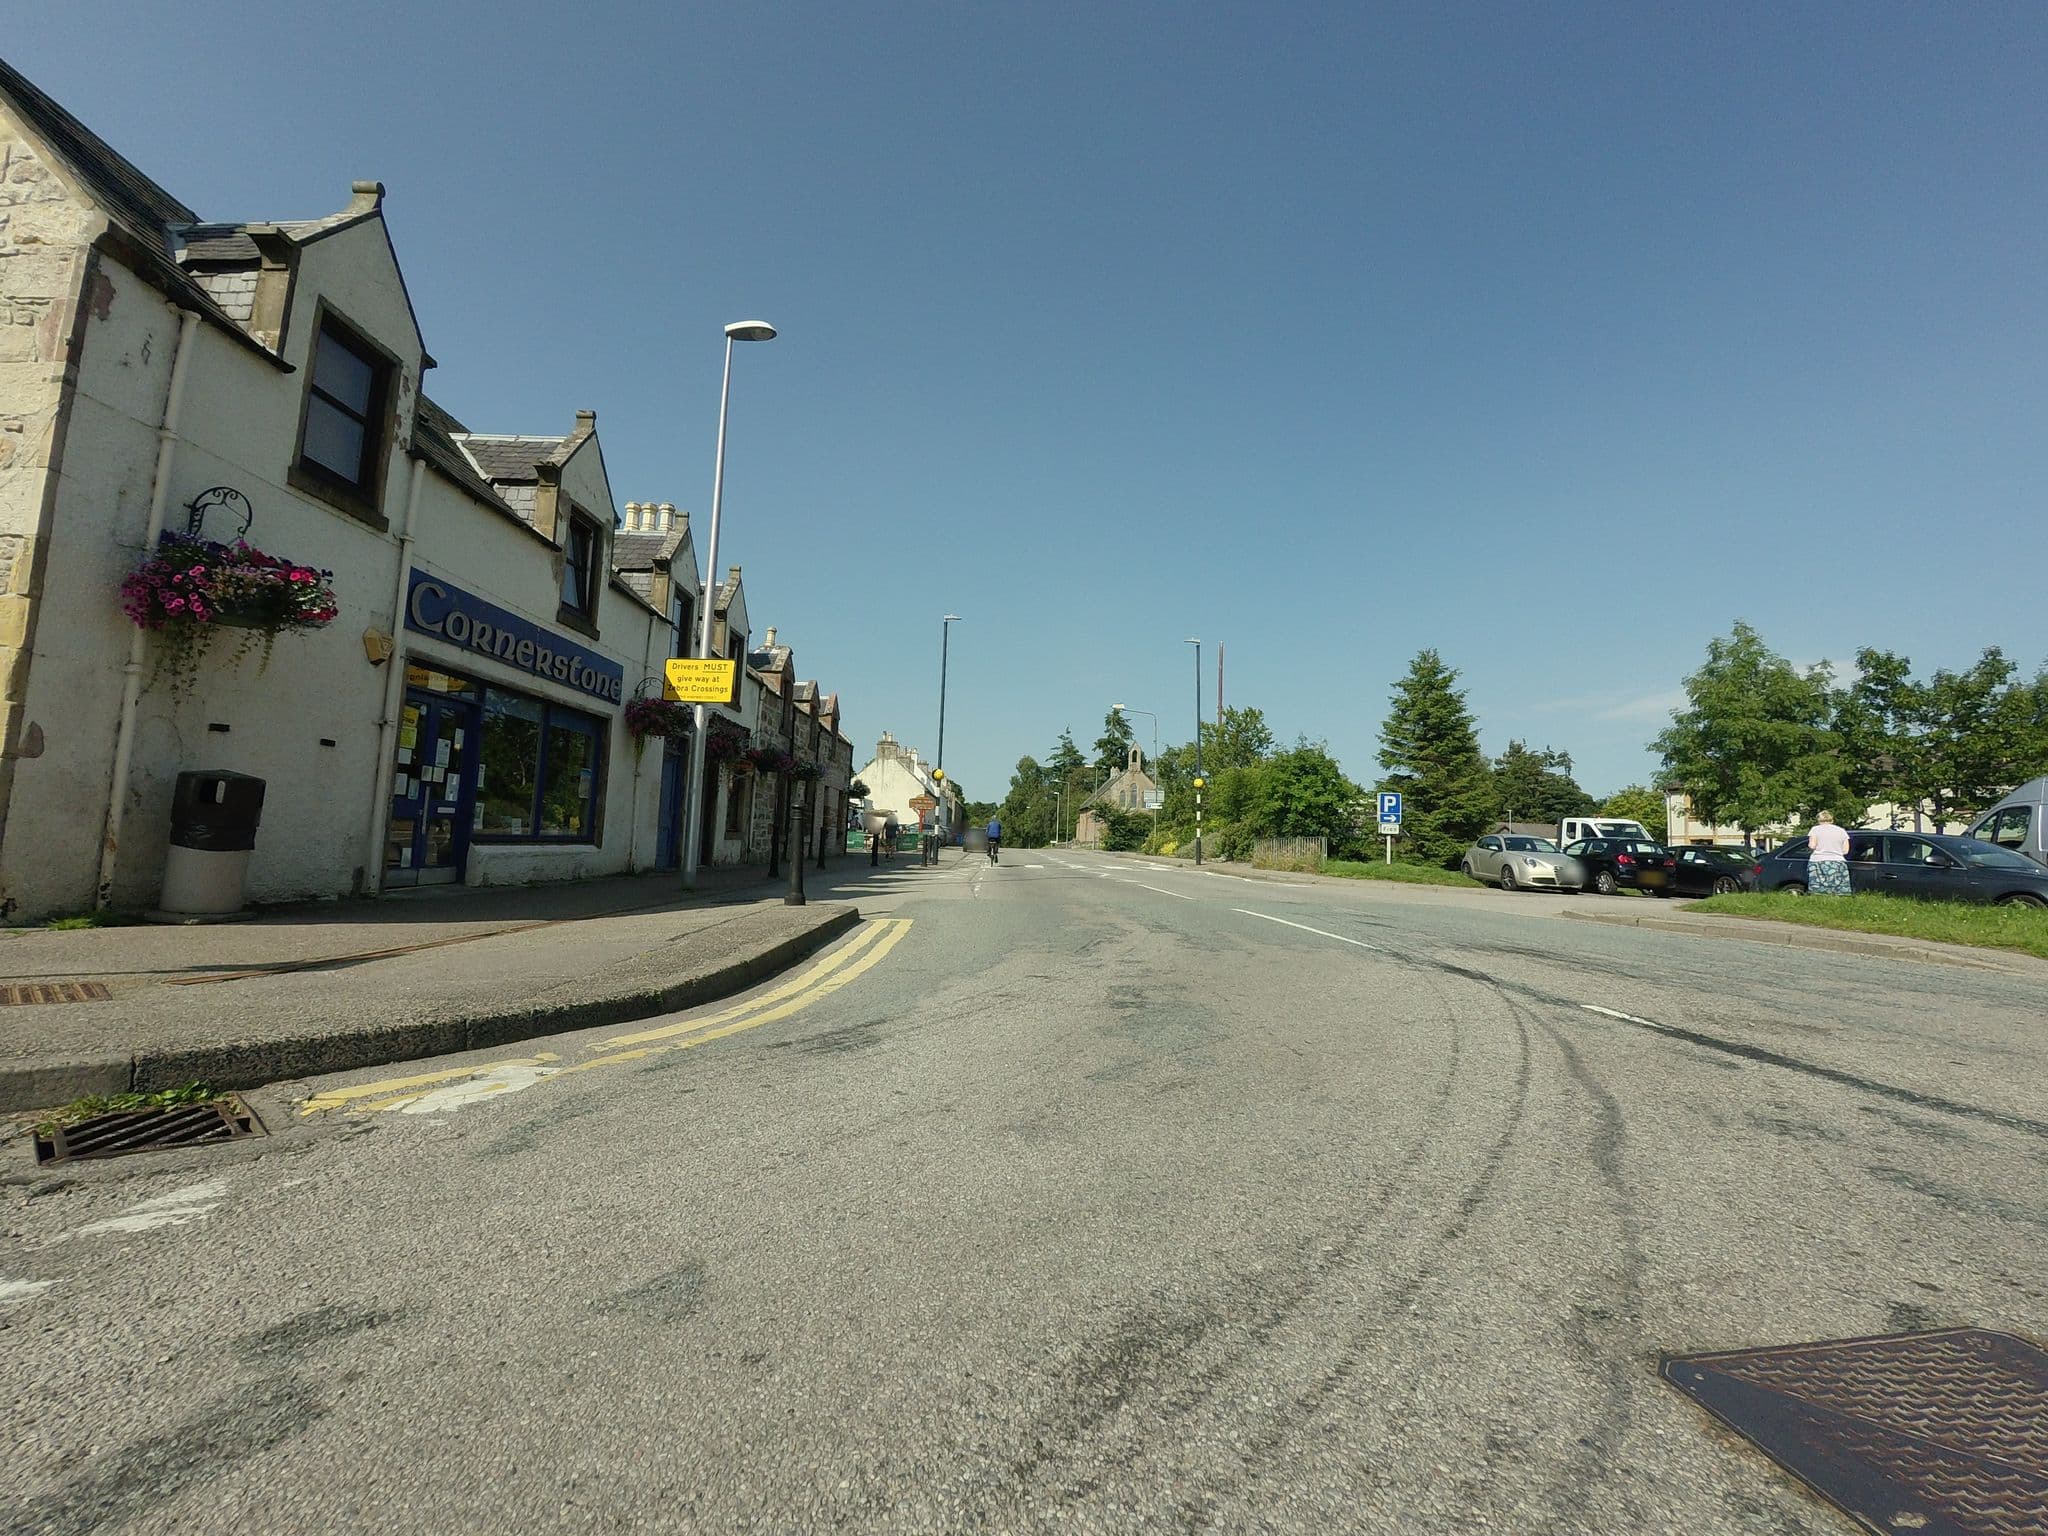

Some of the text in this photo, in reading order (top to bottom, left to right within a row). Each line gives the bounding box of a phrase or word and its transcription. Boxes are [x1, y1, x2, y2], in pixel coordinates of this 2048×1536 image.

[411, 581, 622, 700] Cornerstone
[704, 663, 728, 671] MUST
[677, 675, 692, 683] give
[691, 684, 728, 694] Crossings
[1384, 795, 1396, 812] P
